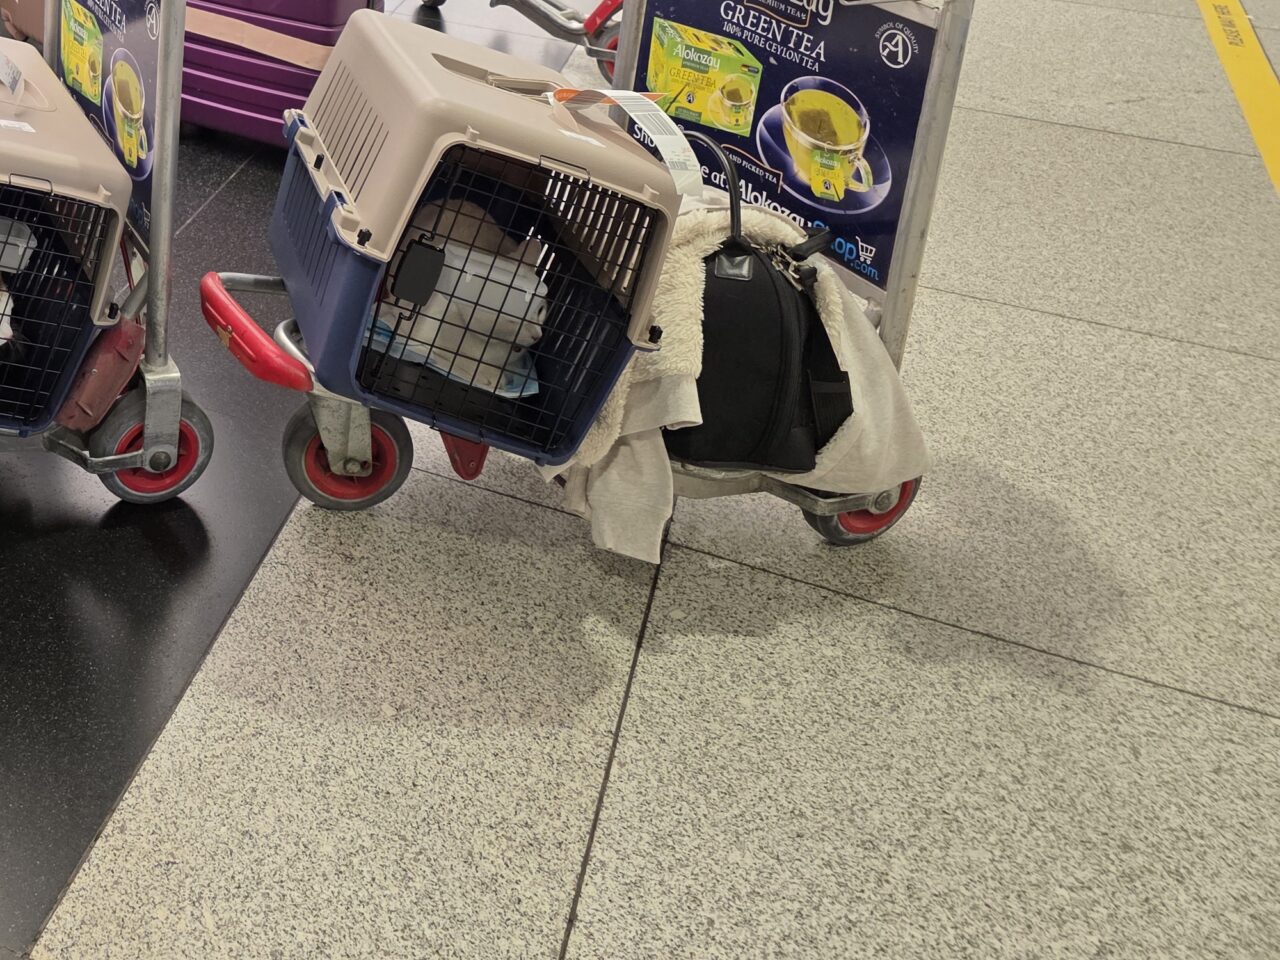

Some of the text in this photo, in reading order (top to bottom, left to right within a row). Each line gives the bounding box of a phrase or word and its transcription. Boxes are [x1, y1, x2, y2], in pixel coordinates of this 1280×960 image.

[111, 1, 126, 34] TEA
[786, 6, 801, 18] TEA
[720, 0, 826, 62] GREEN TEA
[874, 22, 919, 54] SYMBOL OF QUALITY
[673, 44, 721, 71] Alokozay
[722, 21, 820, 73] 100% PURE CEYLON TEA
[633, 124, 656, 148] Sho
[742, 159, 765, 177] PICKED
[765, 171, 778, 184] TEA
